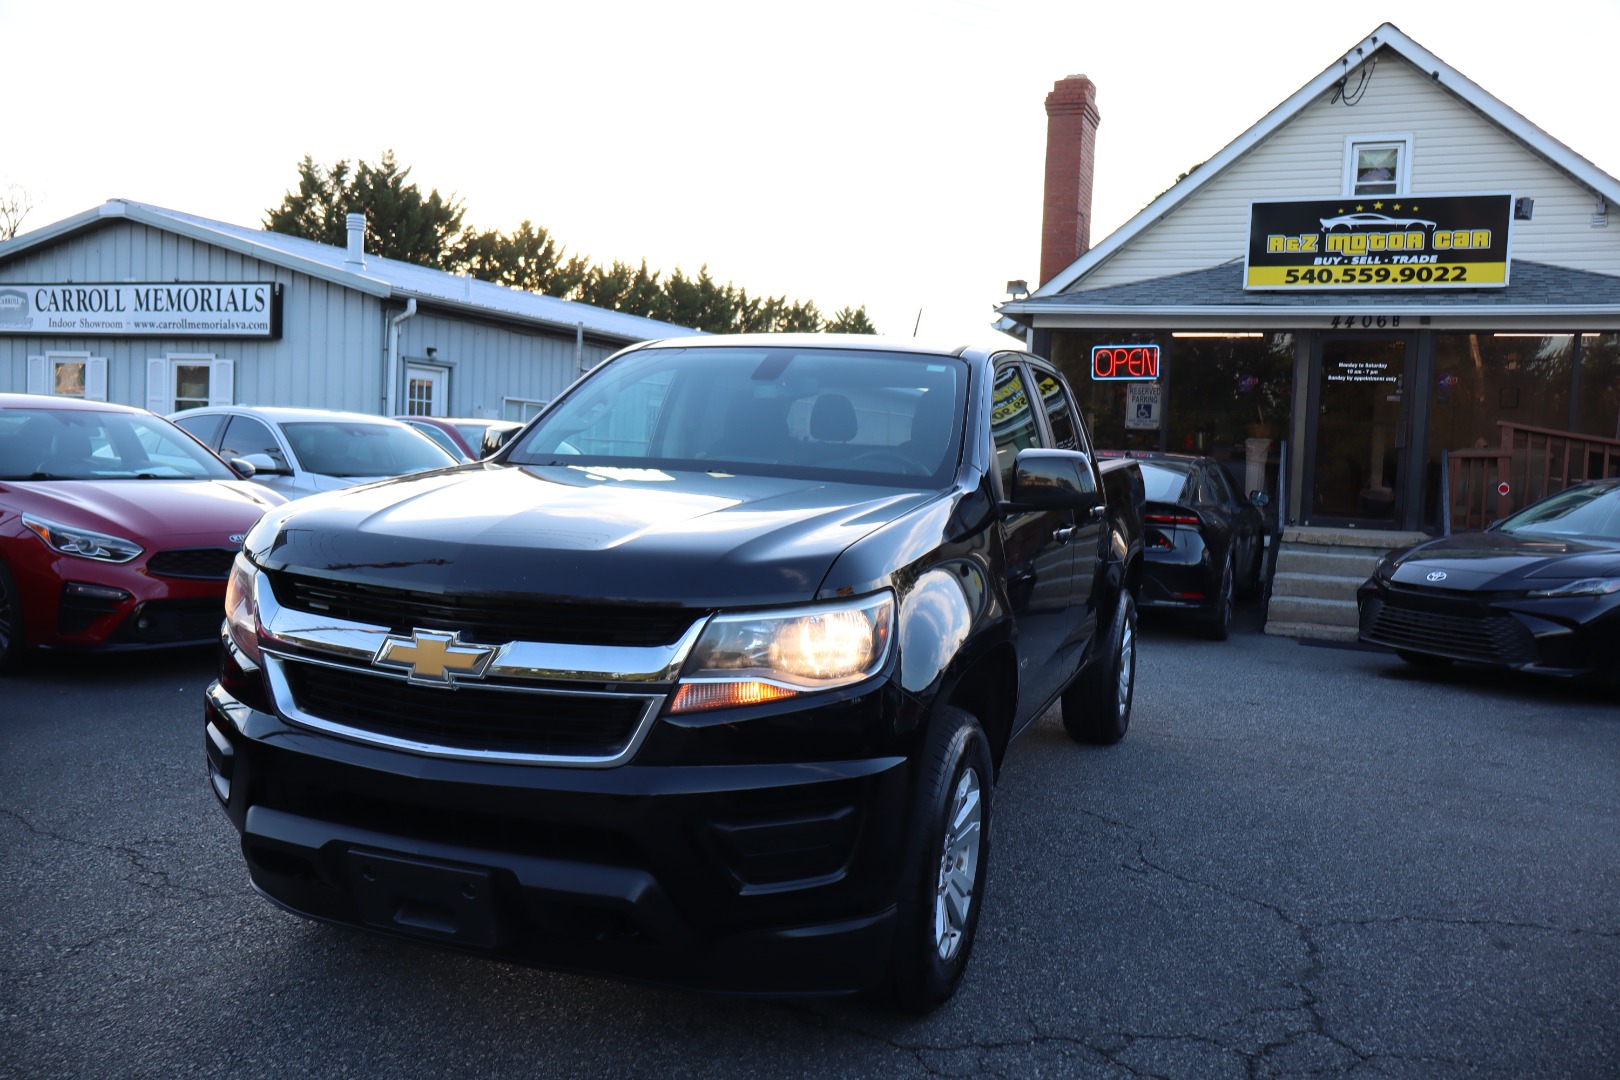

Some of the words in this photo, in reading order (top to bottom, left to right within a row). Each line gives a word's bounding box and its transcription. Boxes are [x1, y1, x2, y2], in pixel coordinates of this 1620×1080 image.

[1313, 256, 1342, 266] BUY
[1351, 256, 1382, 265] SELL
[1392, 255, 1439, 264] TRADE
[1285, 266, 1468, 284] 540.559.9022
[35, 288, 126, 312] CARROLL
[134, 287, 265, 312] MEMORIALS
[48, 318, 77, 329] Indoor
[79, 318, 123, 329] Showroom
[133, 318, 268, 331] www.carrollmemorialsva.com
[1094, 348, 1158, 377] OPEN
[1130, 387, 1161, 396] RESERVED
[1132, 395, 1158, 404] PARKING
